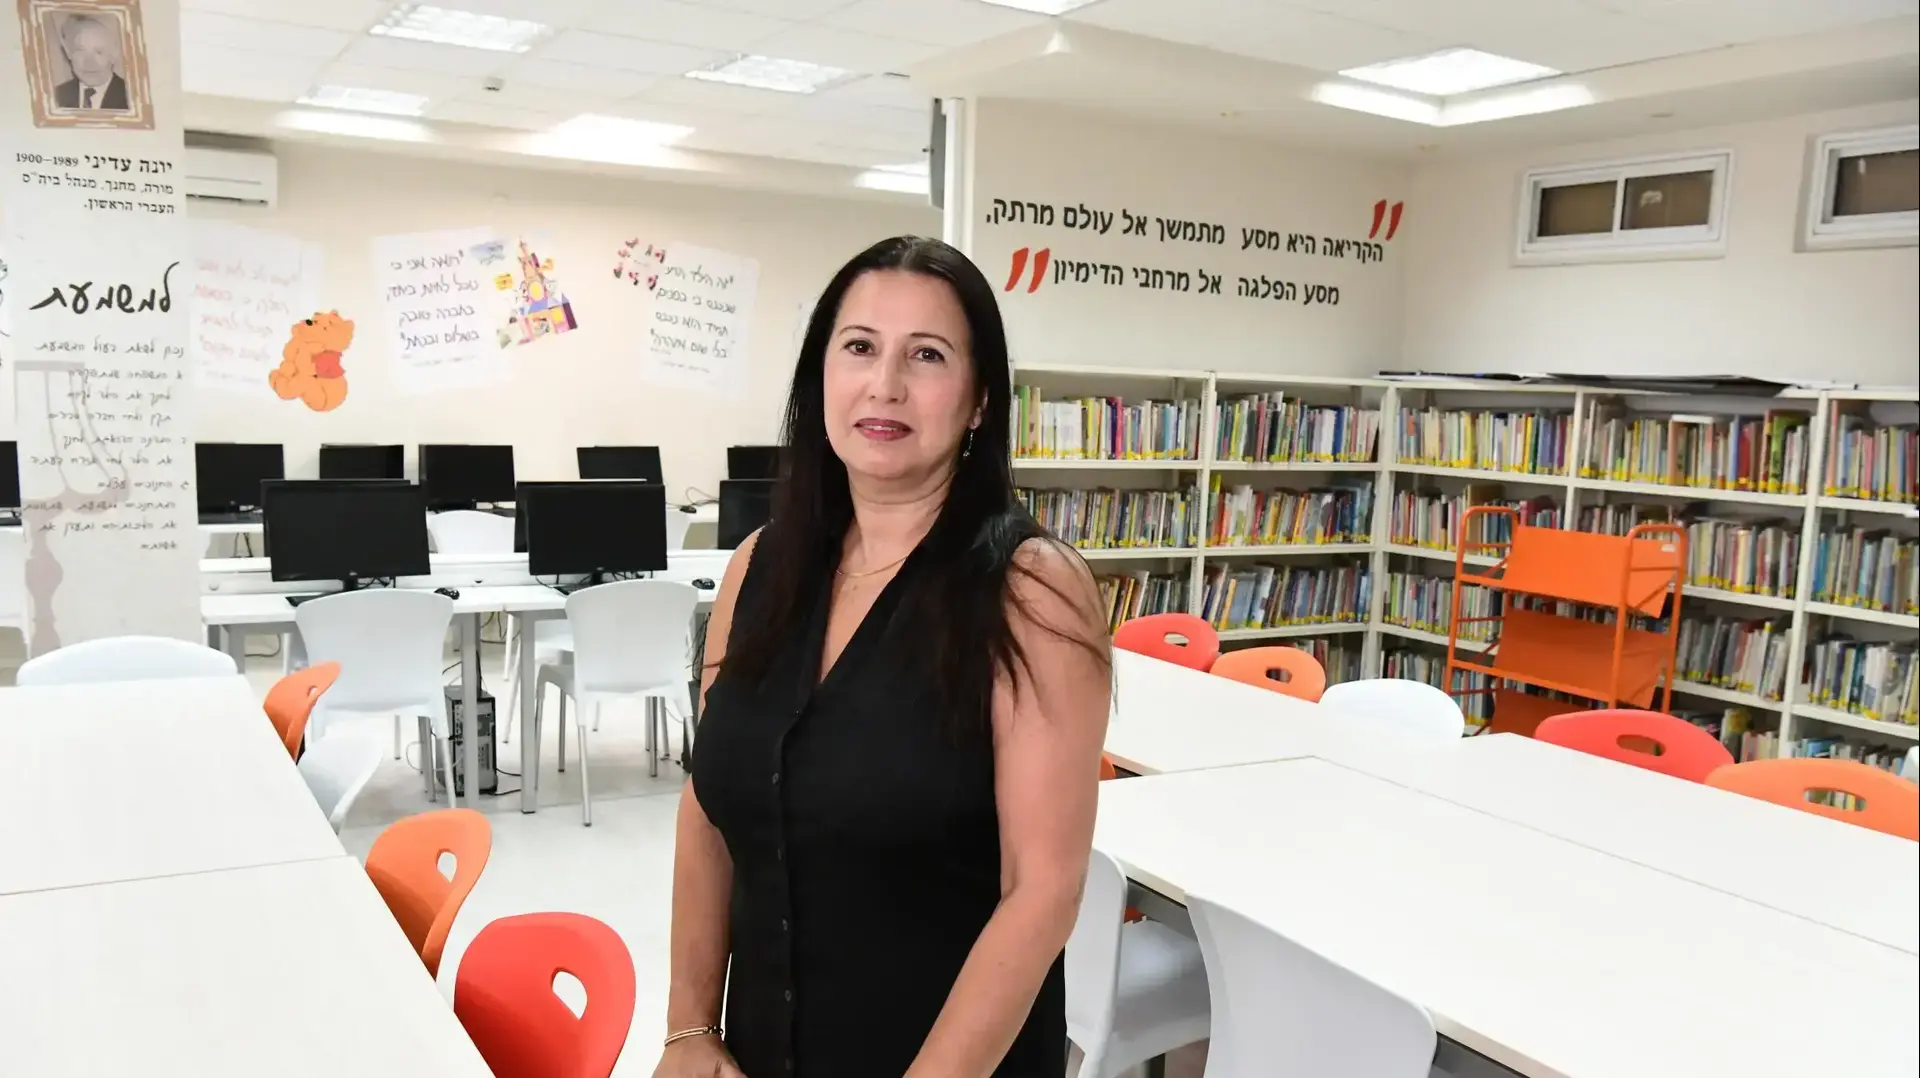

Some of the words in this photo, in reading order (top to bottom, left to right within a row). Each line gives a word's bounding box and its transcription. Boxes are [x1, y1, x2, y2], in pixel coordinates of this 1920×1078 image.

[84, 154, 131, 172] עדיני
[139, 158, 173, 174] יונה
[65, 172, 97, 189] מנהל
[137, 201, 175, 215] העברי
[1062, 203, 1114, 235] עולם
[1122, 208, 1149, 236] אל
[1156, 216, 1225, 245] מתמשך
[1241, 227, 1280, 250] מסע
[1286, 232, 1316, 254] היא
[1322, 236, 1384, 264] הקריאה
[1054, 259, 1124, 285] הדימיון
[1132, 266, 1190, 292] מרחבי
[1198, 269, 1222, 295] אל
[29, 261, 180, 315] למשמעת
[1237, 275, 1297, 301] הפלגה
[1303, 284, 1340, 306] מסע
